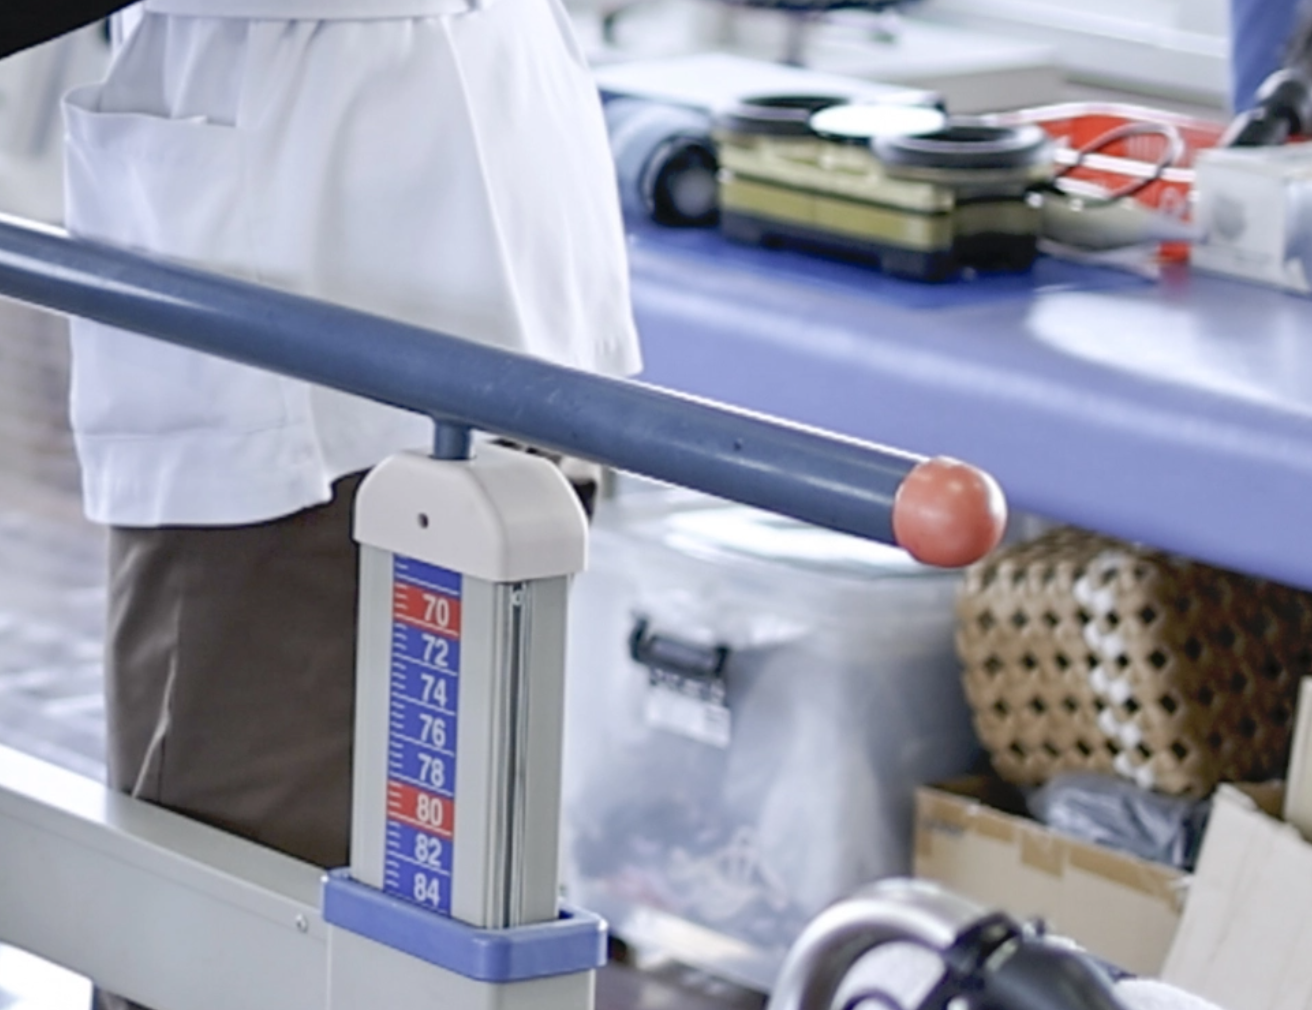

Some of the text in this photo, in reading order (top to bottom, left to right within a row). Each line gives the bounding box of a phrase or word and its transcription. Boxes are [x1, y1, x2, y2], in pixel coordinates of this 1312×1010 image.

[423, 595, 450, 627] 70
[422, 633, 449, 668] 72
[421, 673, 448, 707] 74
[419, 714, 446, 748] 76
[418, 753, 445, 787] 78
[417, 794, 443, 827] 80
[415, 833, 442, 868] 82
[413, 872, 440, 907] 84
